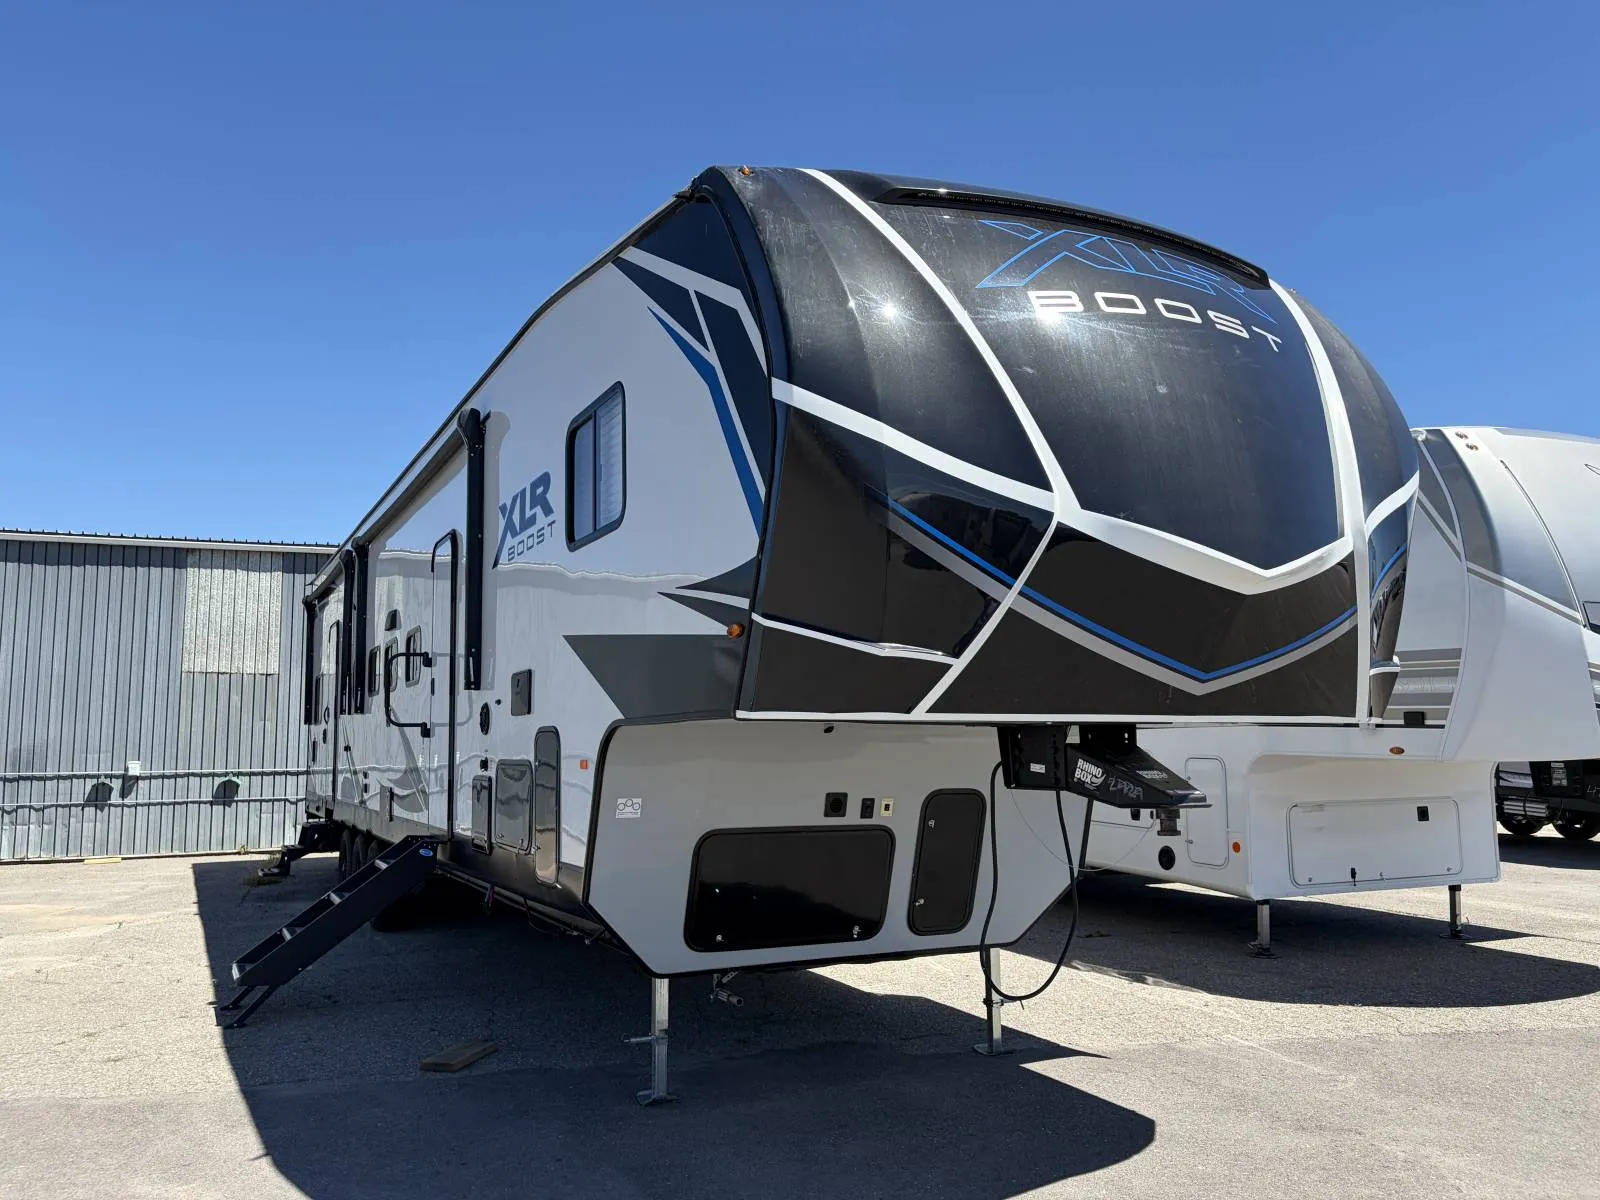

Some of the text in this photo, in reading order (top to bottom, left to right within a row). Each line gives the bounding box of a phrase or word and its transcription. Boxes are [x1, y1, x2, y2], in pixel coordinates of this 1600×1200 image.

[975, 219, 1278, 325] XLR
[1027, 290, 1282, 352] BOOST
[492, 471, 555, 569] XLR
[507, 519, 556, 562] BOOST
[1074, 768, 1093, 784] BOX
[1076, 758, 1103, 778] RHINO
